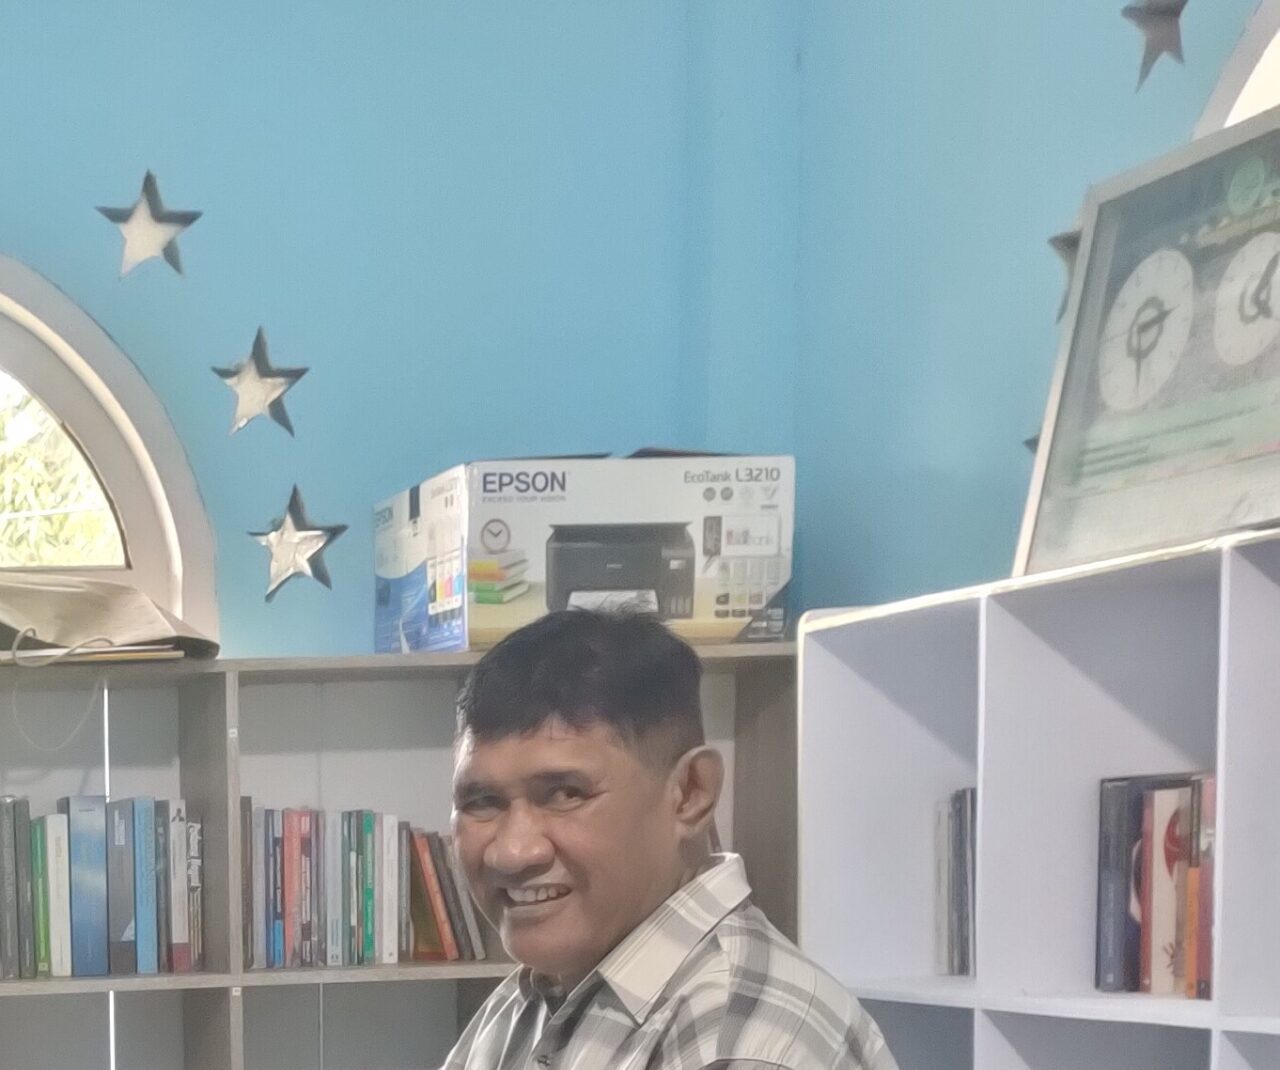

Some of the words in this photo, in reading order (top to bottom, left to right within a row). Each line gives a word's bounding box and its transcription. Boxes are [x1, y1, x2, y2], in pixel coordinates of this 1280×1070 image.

[482, 471, 567, 494] EPSON
[683, 470, 732, 484] EcoTank
[735, 467, 781, 483] L3210
